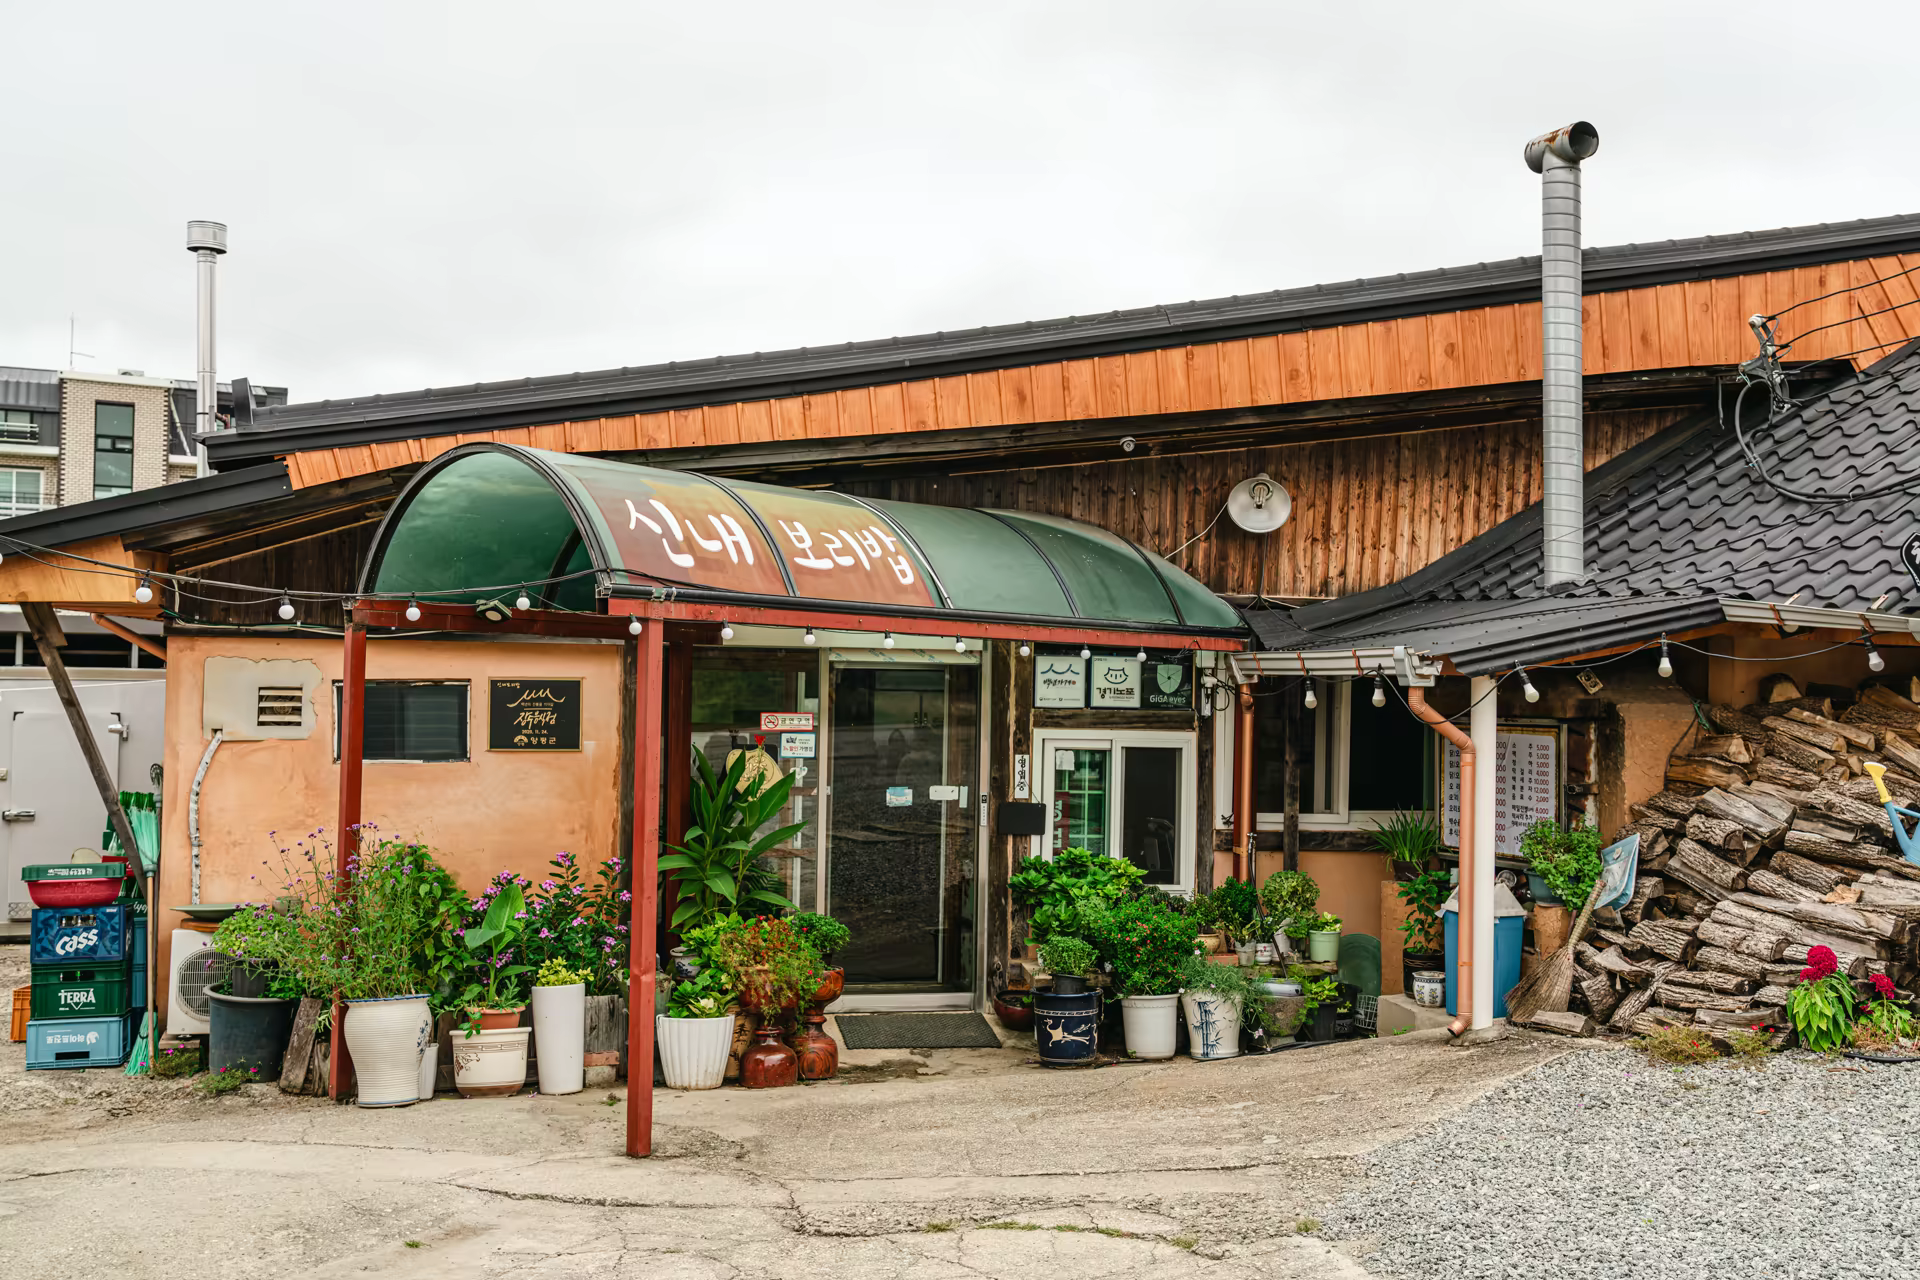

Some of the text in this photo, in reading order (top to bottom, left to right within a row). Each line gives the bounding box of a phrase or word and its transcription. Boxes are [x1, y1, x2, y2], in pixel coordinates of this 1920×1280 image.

[625, 499, 914, 585] 신내 보리밥
[1096, 687, 1135, 699] 경기노포
[56, 928, 98, 955] Cass
[58, 987, 96, 1005] TERRA
